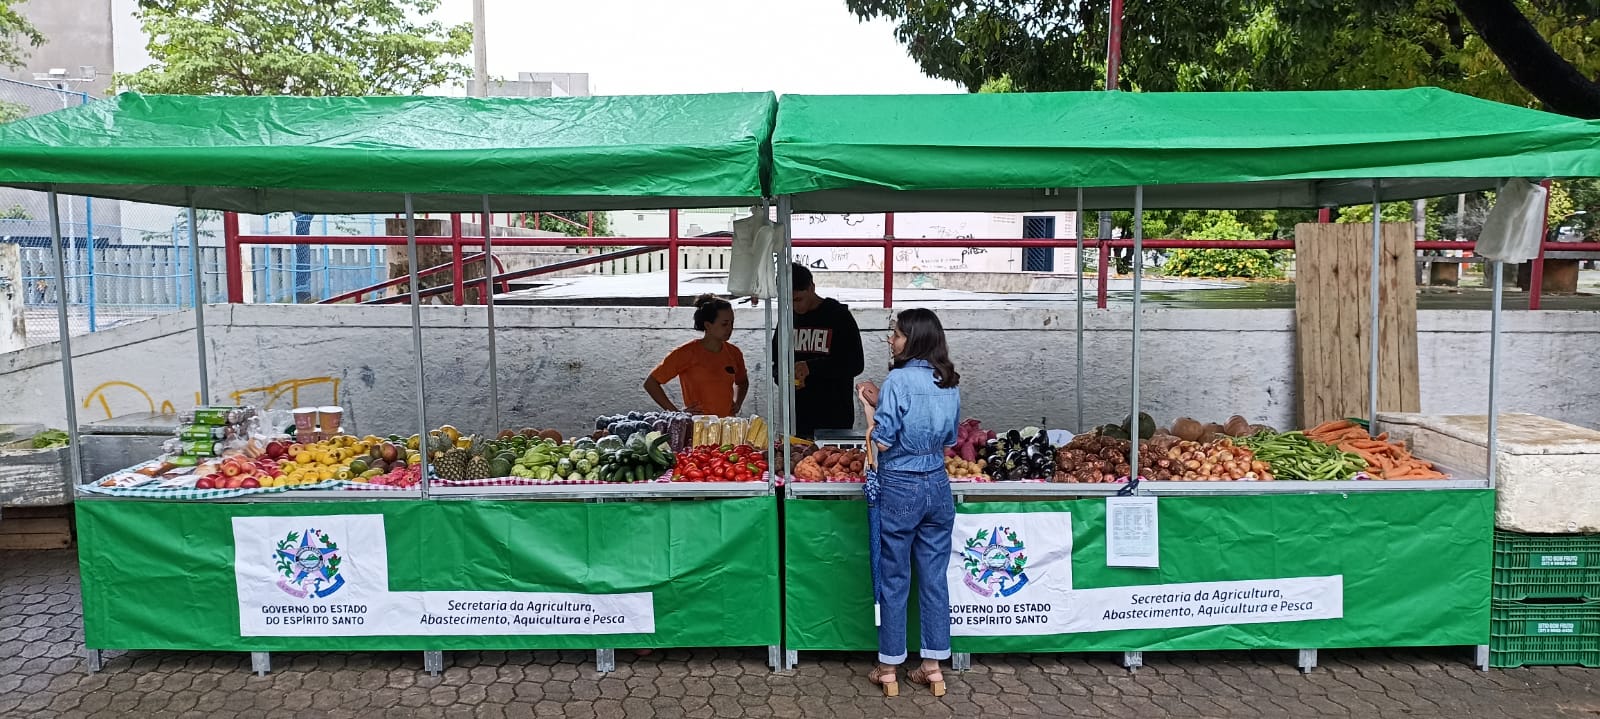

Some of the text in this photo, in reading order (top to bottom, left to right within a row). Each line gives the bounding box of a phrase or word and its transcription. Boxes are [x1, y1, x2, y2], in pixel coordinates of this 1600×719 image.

[793, 328, 829, 352] ARVEL
[1131, 587, 1284, 605] Secretaria da Agricultura,
[262, 604, 368, 614] GOVERNO DO ESTADO
[448, 599, 596, 613] Secretaria da Agricultura,
[996, 604, 1011, 614] DO
[1013, 603, 1051, 613] ESTADO
[1102, 600, 1313, 620] Abastecimento, Aquicultura e Pesca
[266, 614, 364, 625] DO ESPÍRITO SANTO
[420, 614, 625, 627] Abastecimento, Aquicultura e Pesca
[950, 614, 1048, 625] DO ESPÍRITO SANTO
